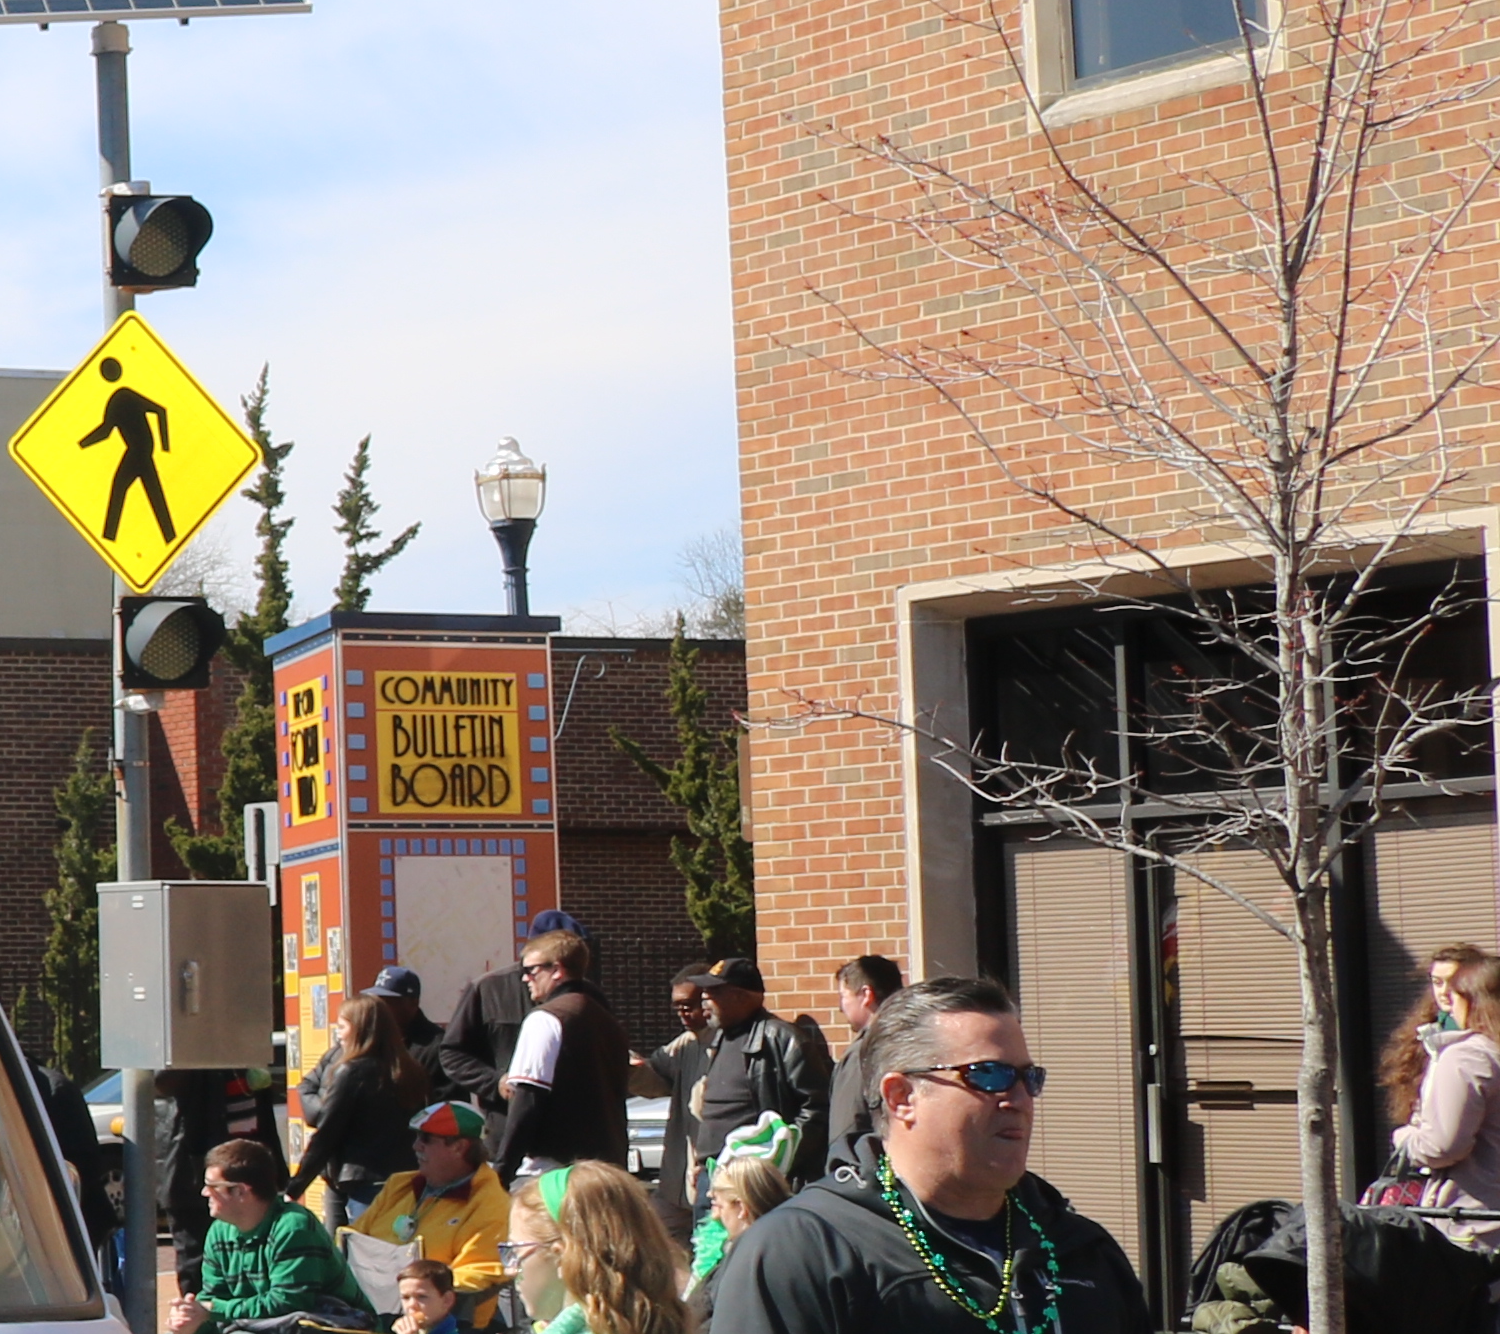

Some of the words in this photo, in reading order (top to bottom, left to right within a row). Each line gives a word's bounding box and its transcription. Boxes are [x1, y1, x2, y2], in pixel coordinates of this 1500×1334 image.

[380, 674, 517, 708] COMMUNITY
[392, 713, 505, 760] BULLETIN
[390, 762, 512, 809] BOARD
